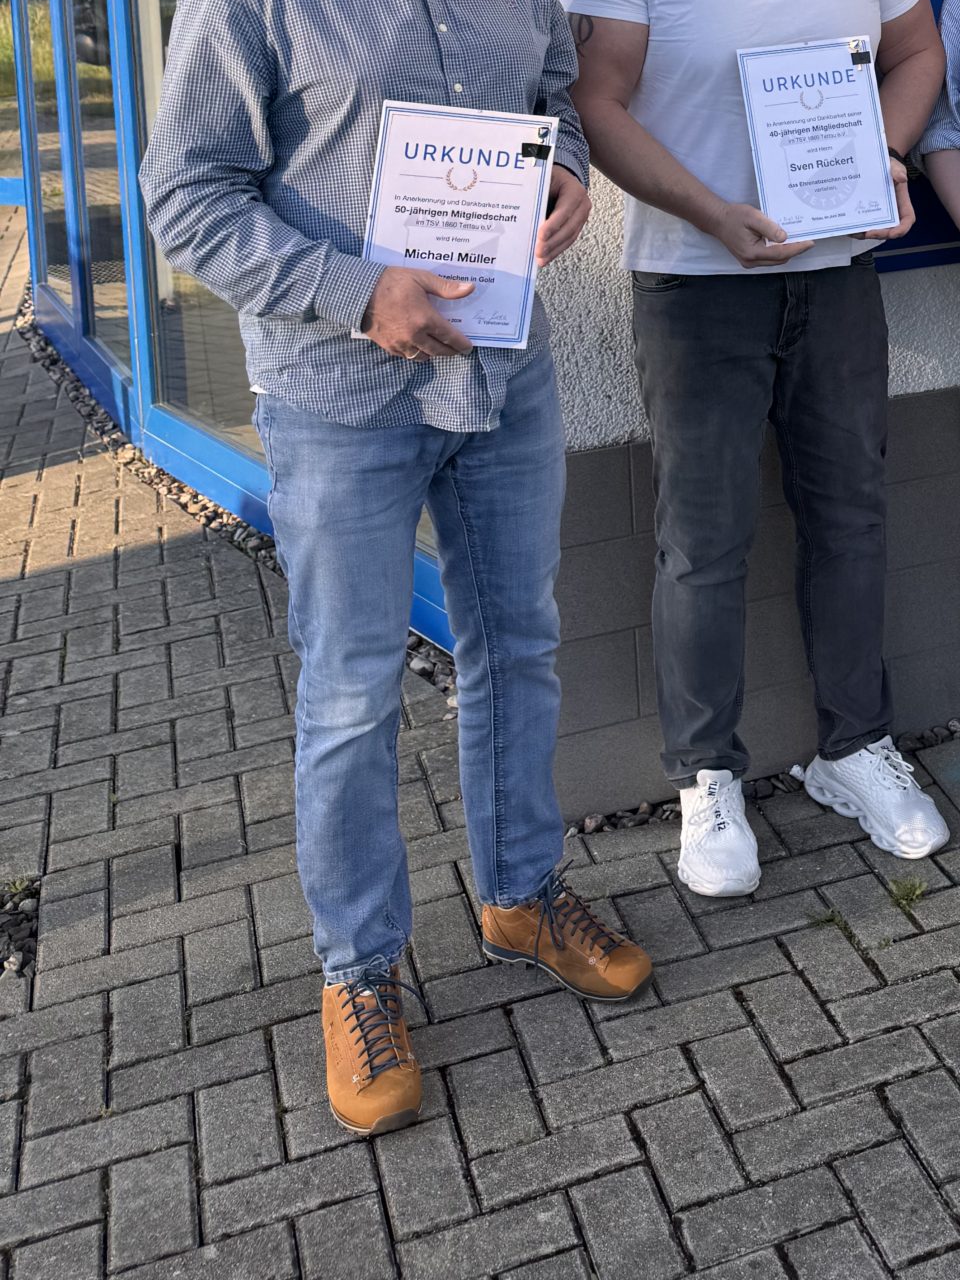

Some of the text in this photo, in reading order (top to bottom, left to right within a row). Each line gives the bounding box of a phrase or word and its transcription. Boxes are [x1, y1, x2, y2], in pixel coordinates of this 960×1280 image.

[762, 68, 856, 93] URKUNDE
[769, 119, 863, 138] 40-jährigen Mitgliedschaft
[404, 142, 526, 170] URKUNDE
[790, 156, 855, 172] Sven Rückert
[402, 194, 446, 207] Anerkennung
[447, 198, 460, 206] und
[461, 199, 500, 210] Dankbarkeit
[501, 203, 520, 211] seiner
[394, 205, 518, 223] 50-jährigen Mitgliedschaft
[424, 220, 440, 228] TSV
[441, 221, 458, 229] 1860
[458, 222, 479, 231] Tettau
[451, 236, 470, 244] Herrn
[404, 248, 497, 265] Michael Müller
[470, 275, 477, 283] in
[478, 276, 495, 284] Gold
